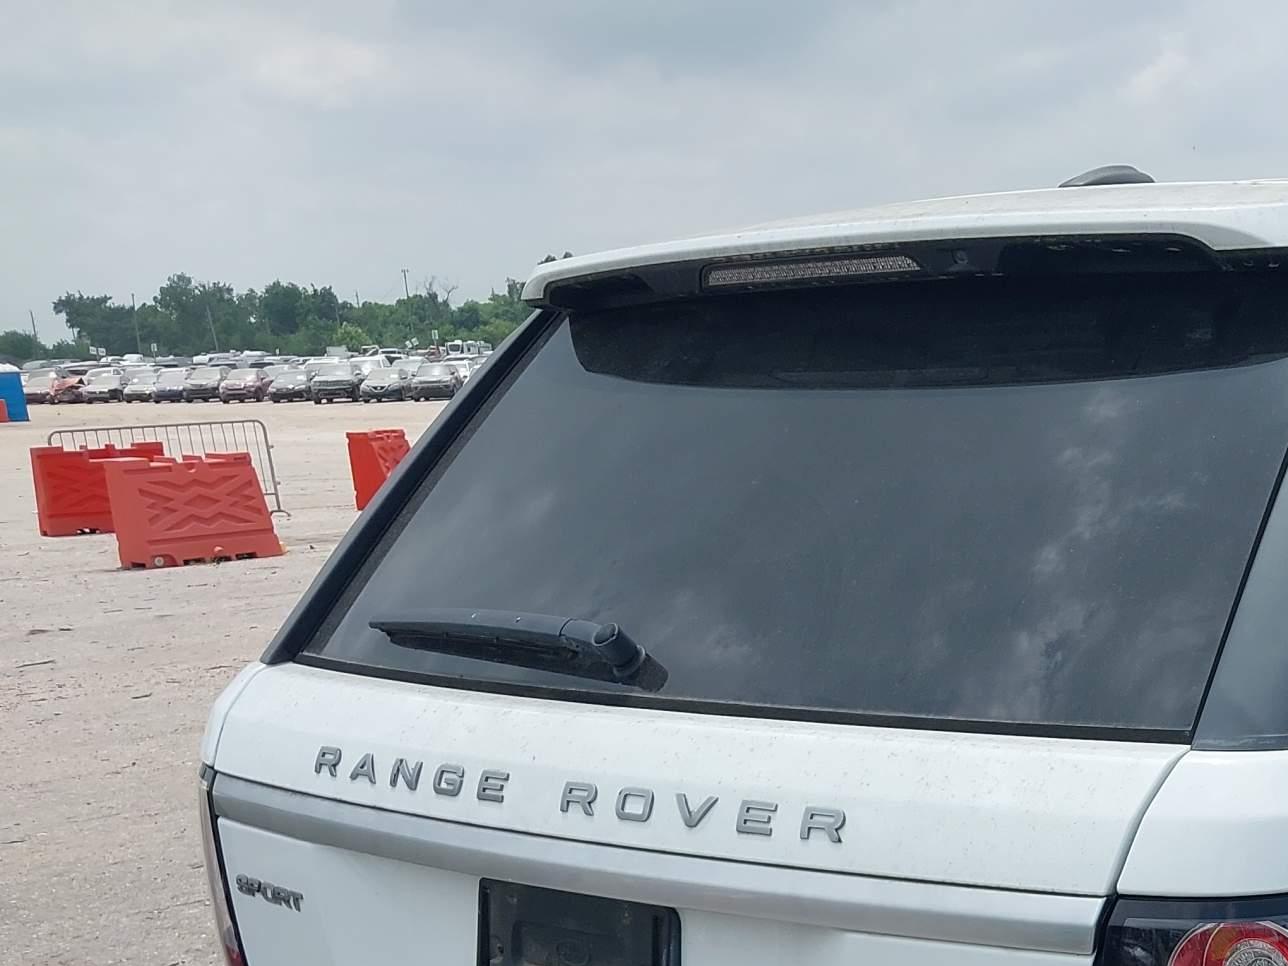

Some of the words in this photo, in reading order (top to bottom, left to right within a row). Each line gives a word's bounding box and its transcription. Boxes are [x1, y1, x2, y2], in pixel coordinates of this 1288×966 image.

[314, 745, 510, 803] RANGE
[560, 781, 847, 843] ROVER
[236, 874, 304, 912] SPORT
